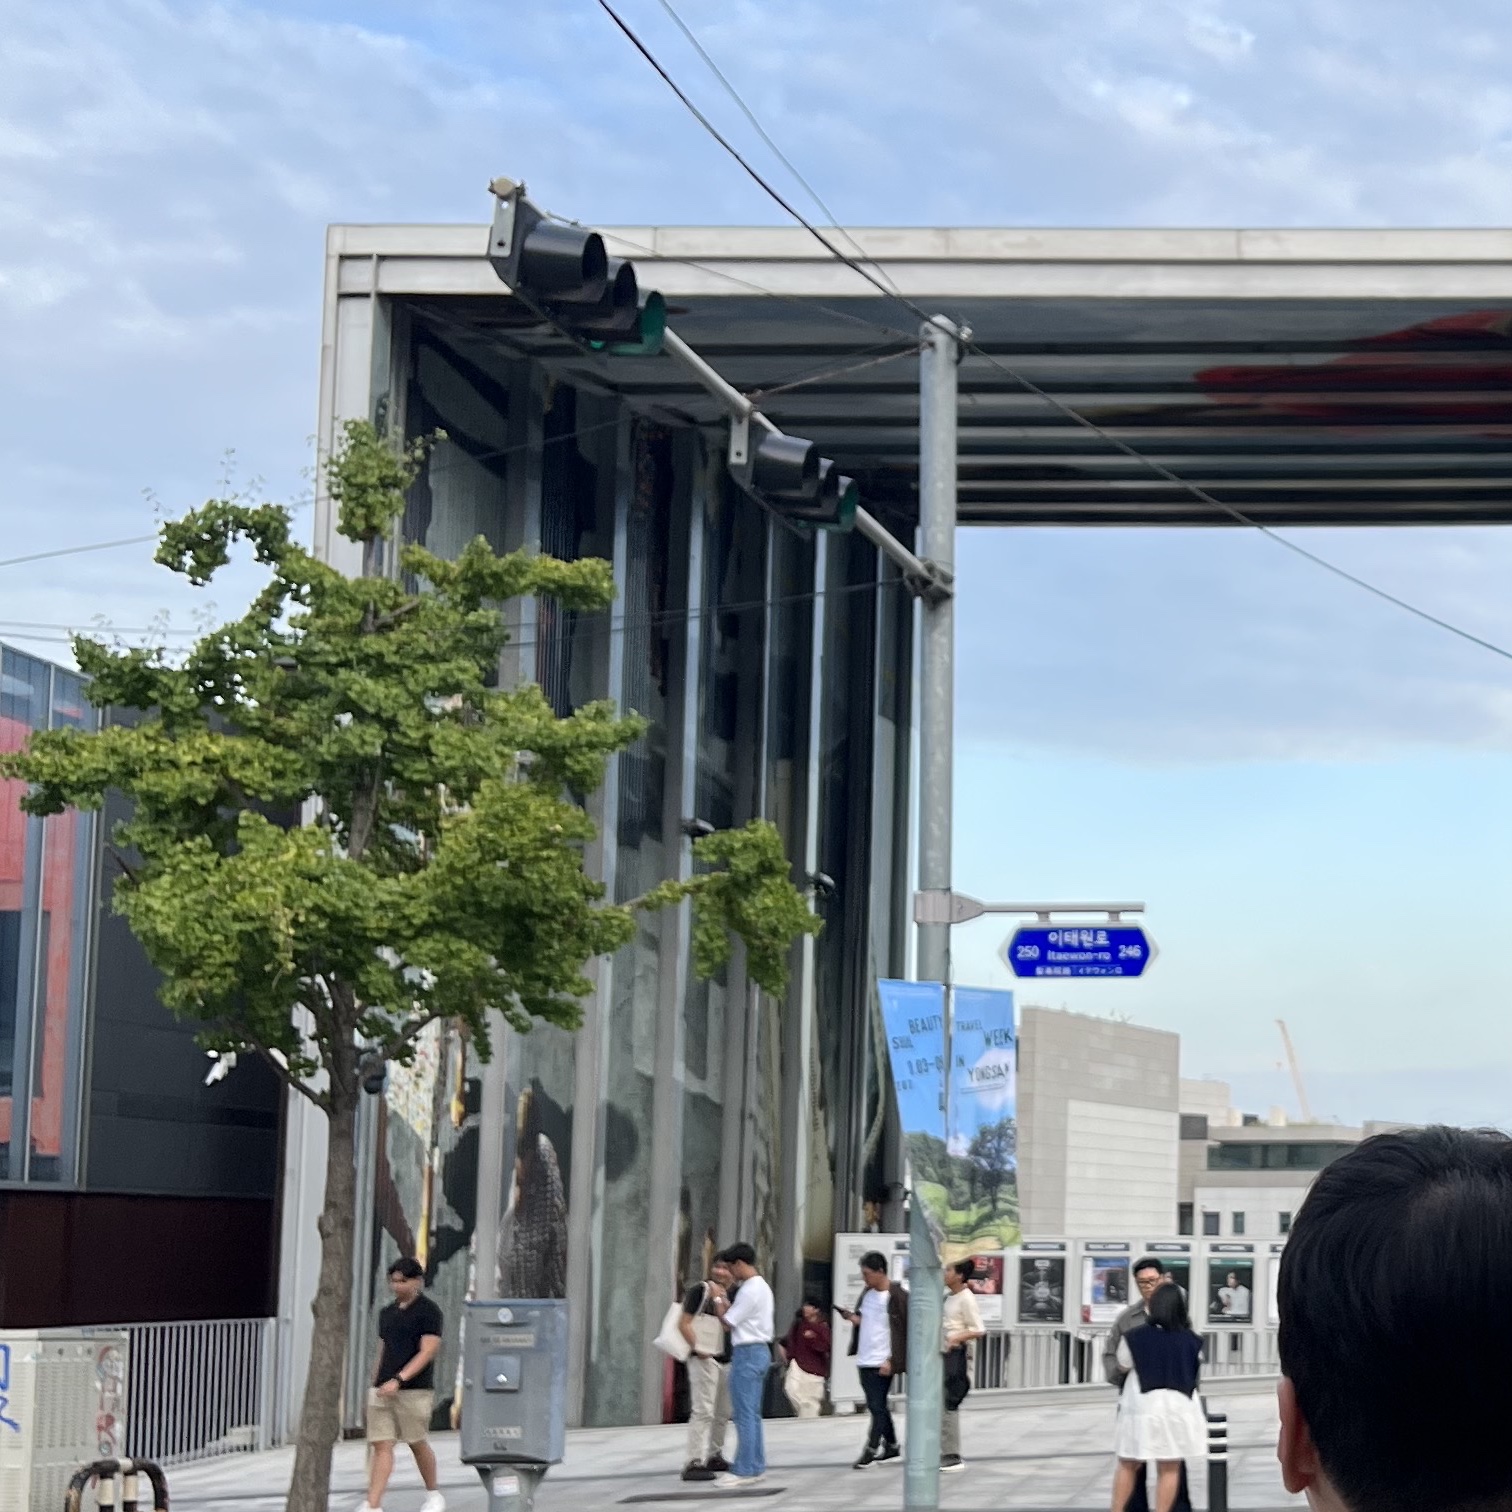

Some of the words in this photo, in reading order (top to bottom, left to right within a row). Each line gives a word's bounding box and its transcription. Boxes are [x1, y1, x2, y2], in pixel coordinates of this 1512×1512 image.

[1048, 929, 1110, 950] 이태원로
[1016, 945, 1039, 959] 250
[1118, 945, 1142, 959] 246
